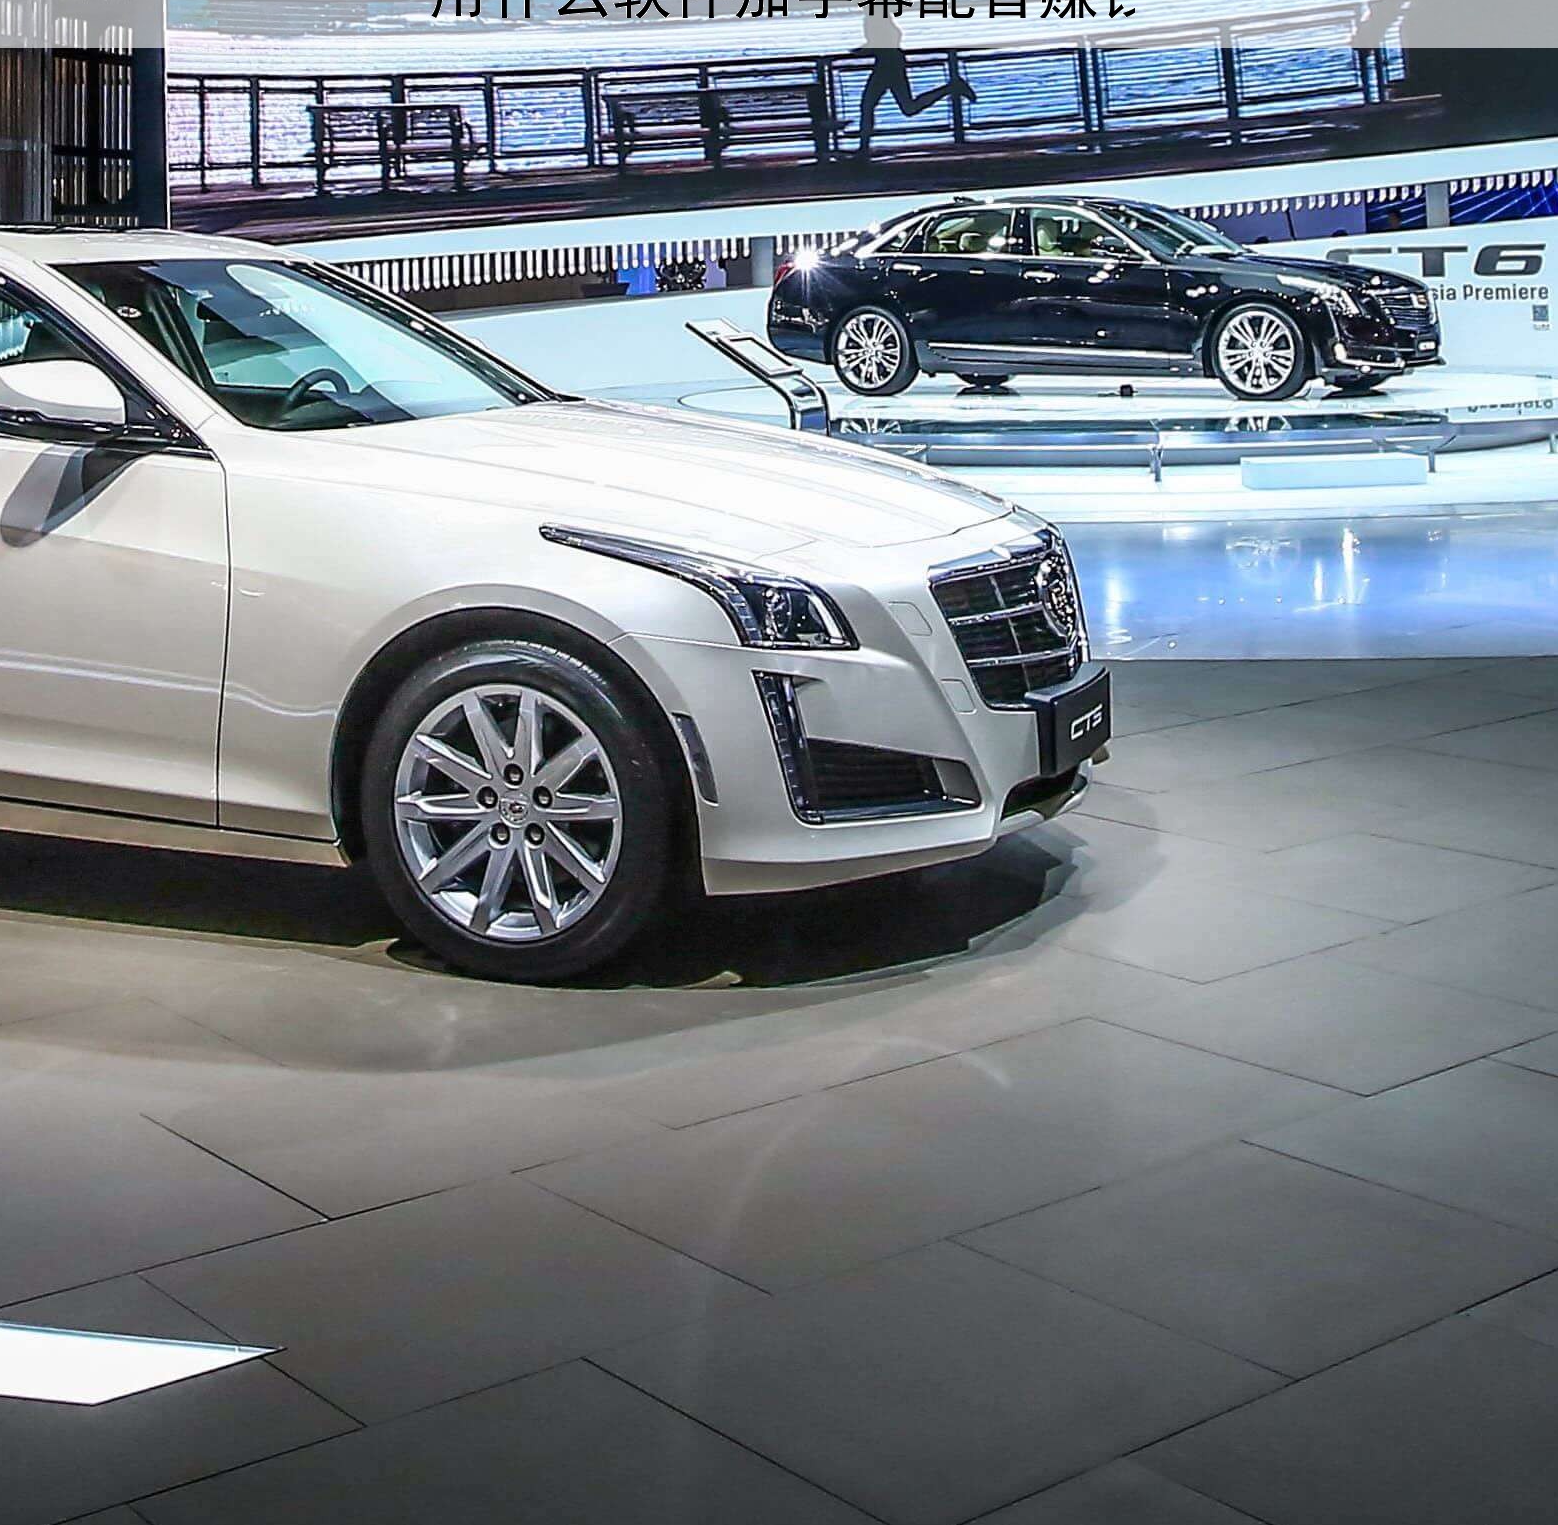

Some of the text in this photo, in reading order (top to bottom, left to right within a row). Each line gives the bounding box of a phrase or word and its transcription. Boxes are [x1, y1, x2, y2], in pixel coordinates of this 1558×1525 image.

[1430, 282, 1550, 301] sia Premiere
[1070, 703, 1103, 740] CTS
